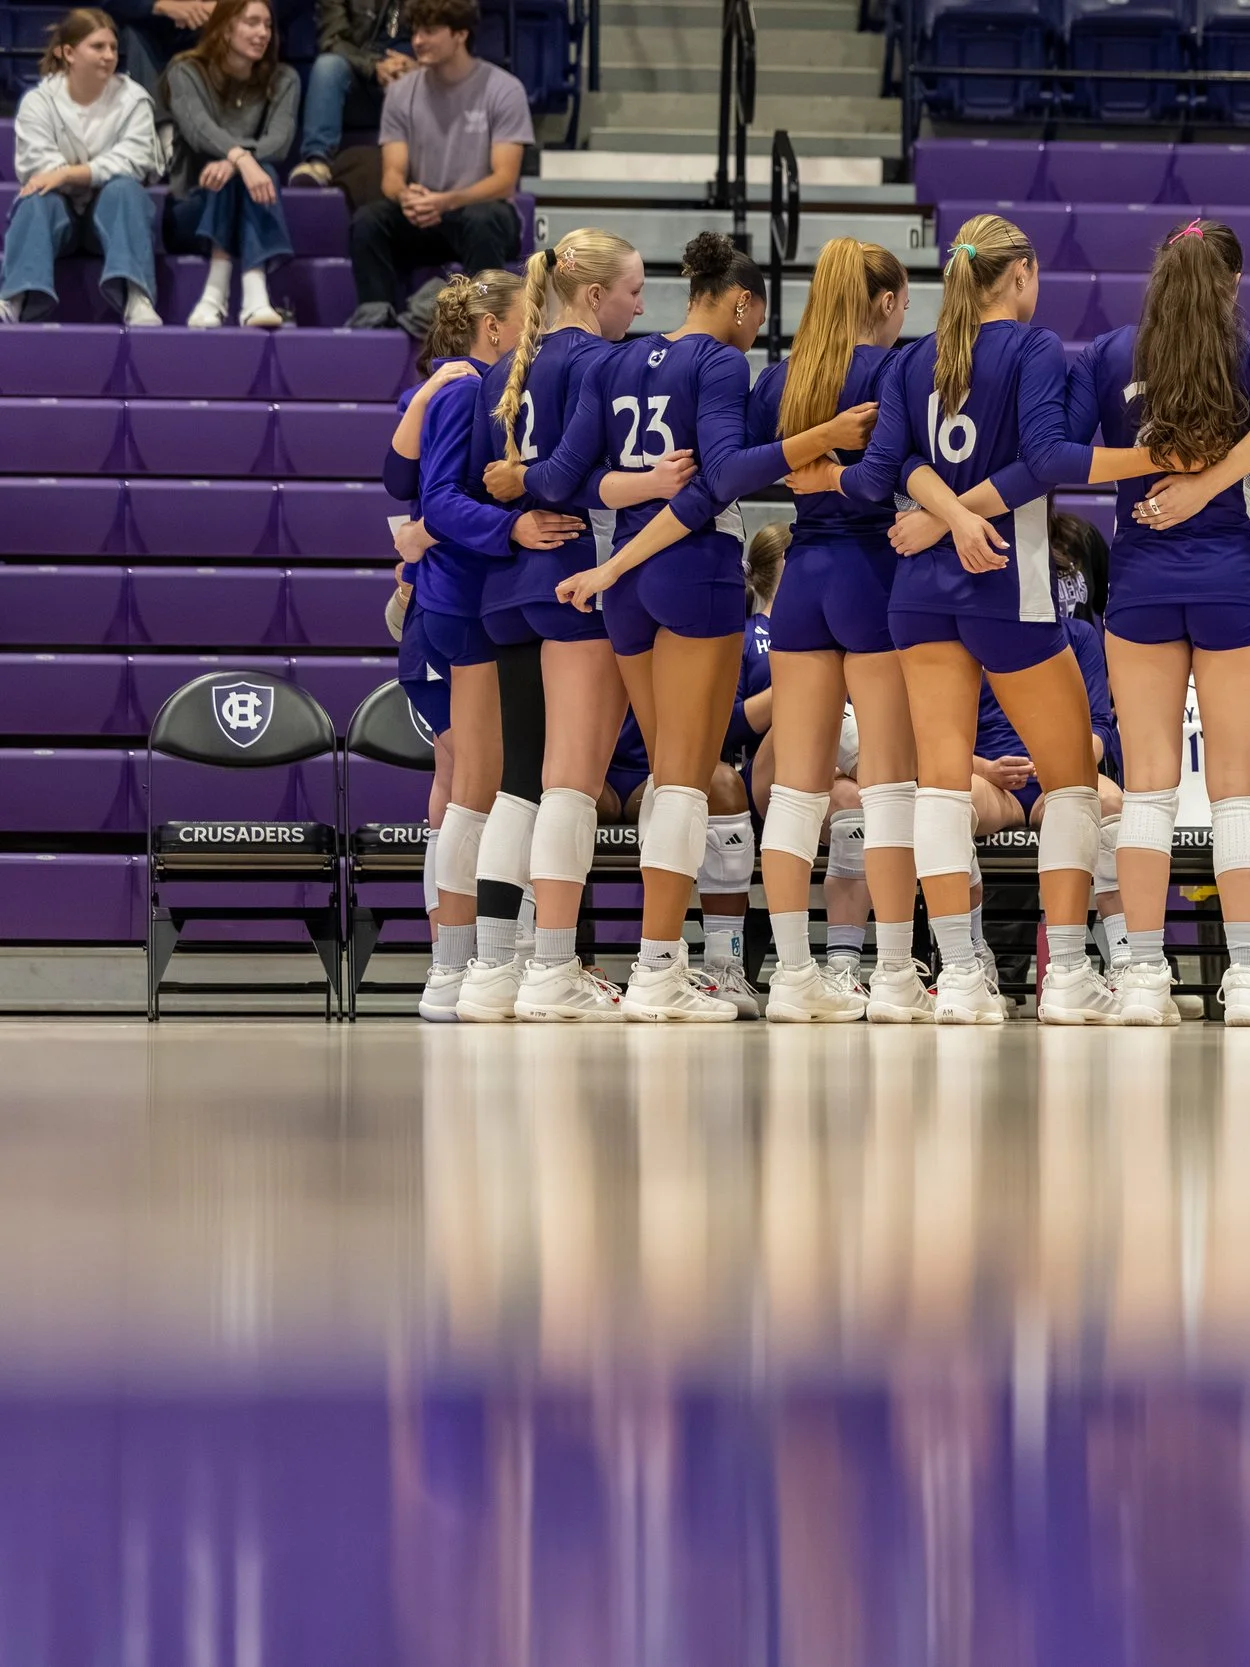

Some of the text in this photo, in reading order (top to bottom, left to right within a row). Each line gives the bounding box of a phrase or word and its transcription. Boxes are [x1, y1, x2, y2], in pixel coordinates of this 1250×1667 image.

[536, 218, 545, 241] C
[612, 396, 675, 468] 23
[927, 388, 977, 464] 16
[179, 827, 305, 843] CRUSADERS
[596, 828, 637, 844] RUS
